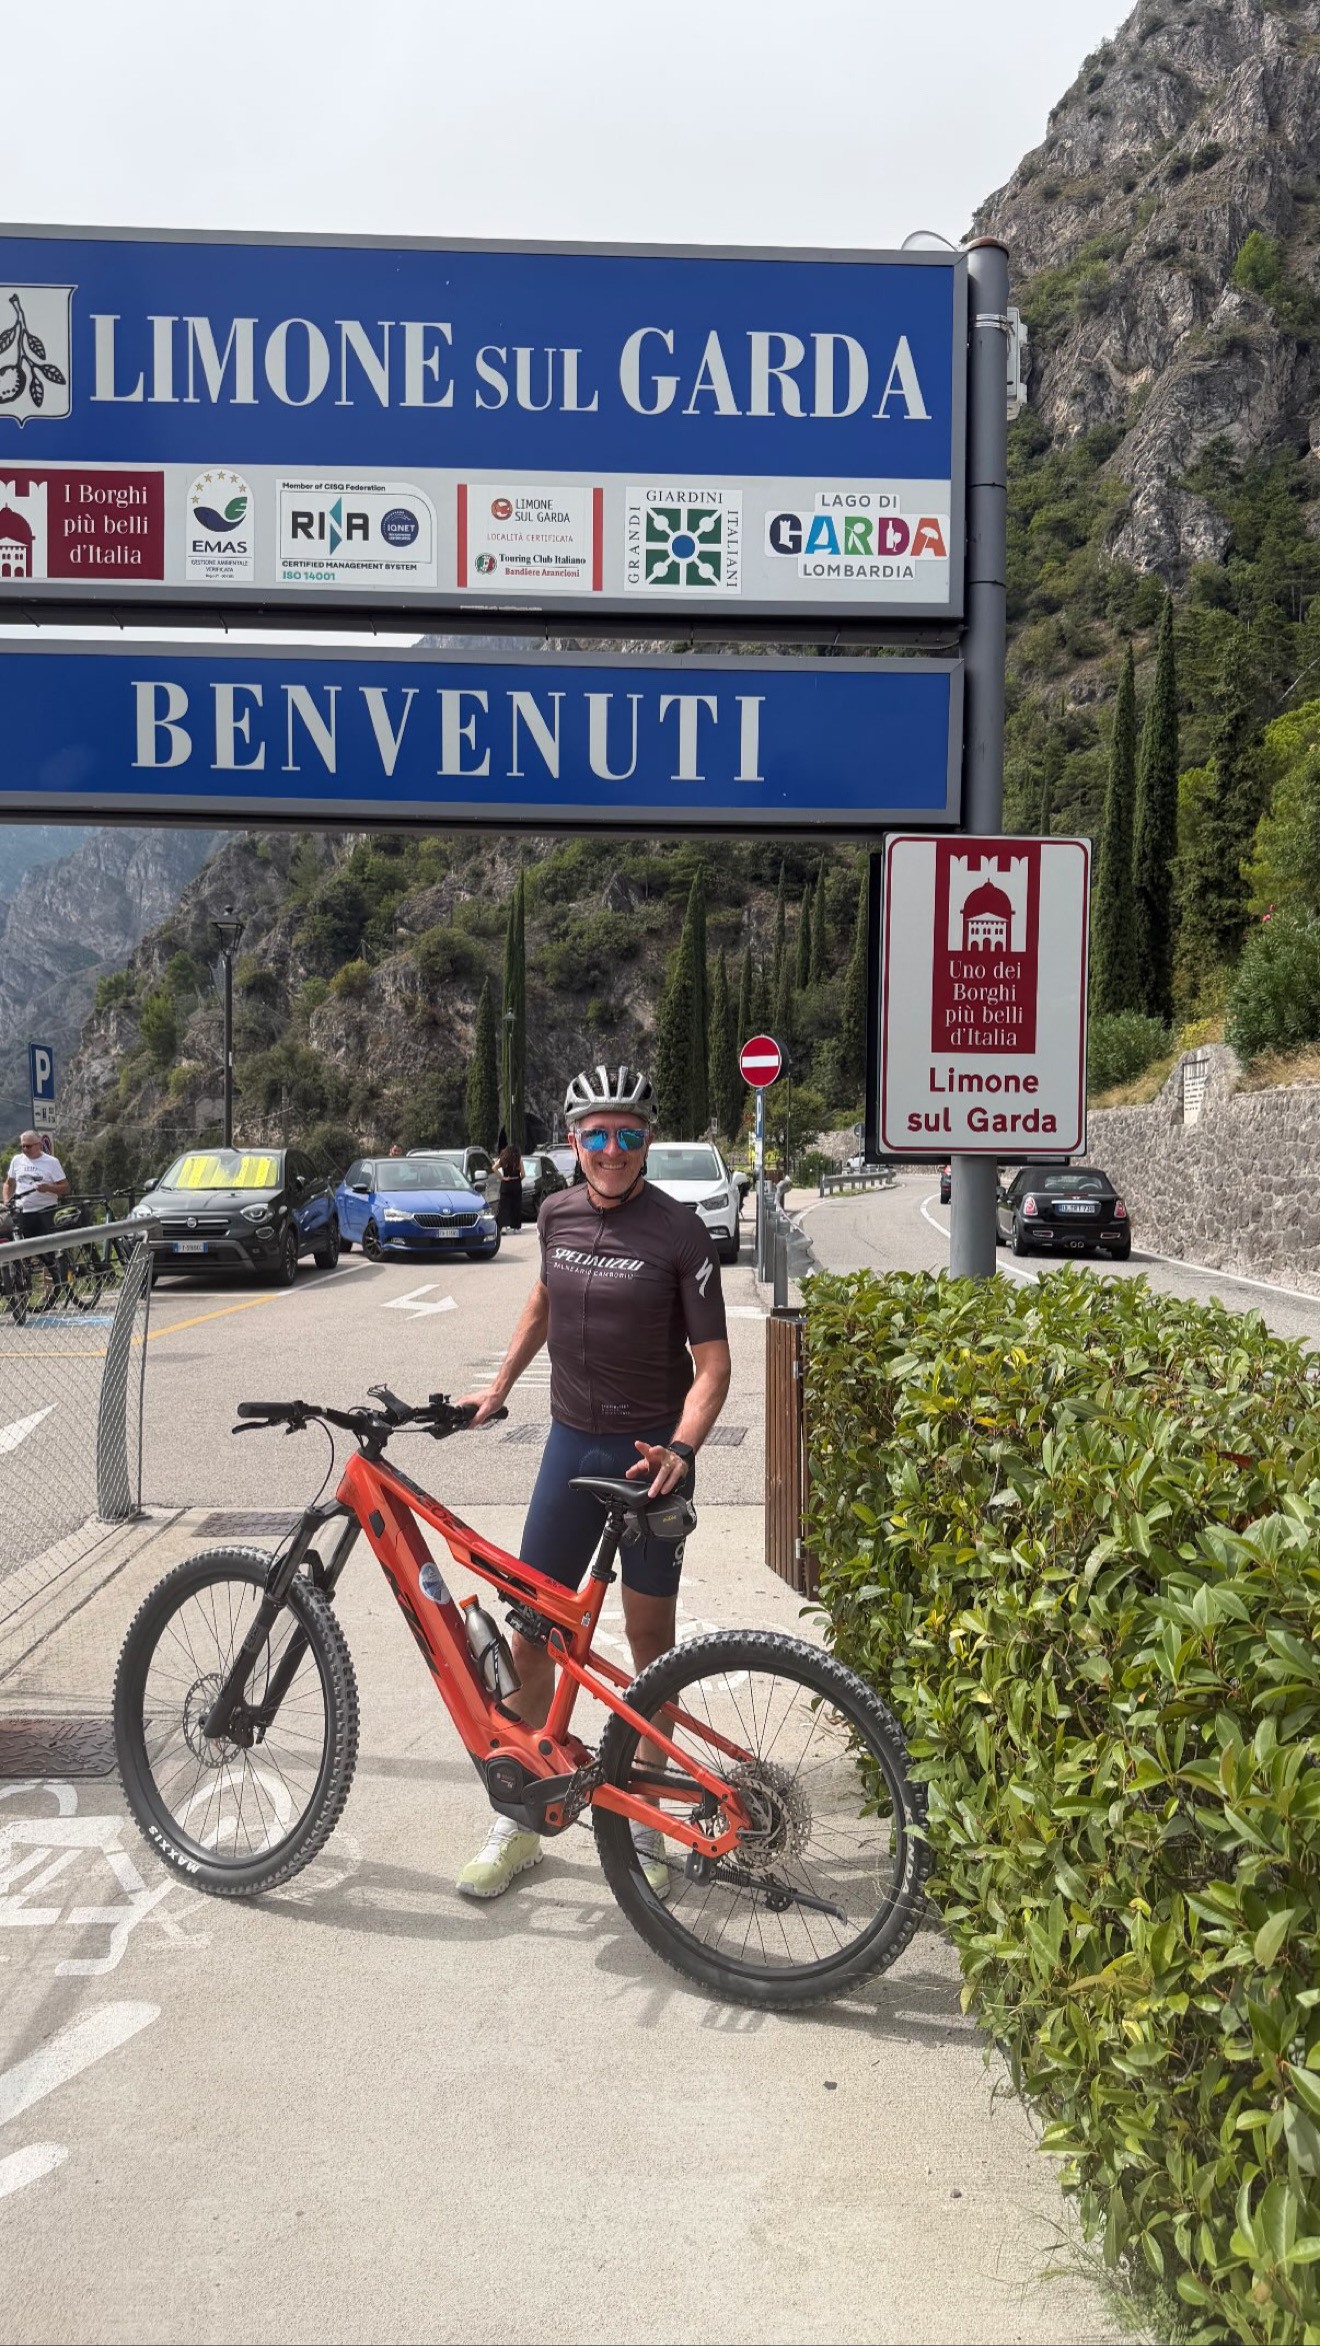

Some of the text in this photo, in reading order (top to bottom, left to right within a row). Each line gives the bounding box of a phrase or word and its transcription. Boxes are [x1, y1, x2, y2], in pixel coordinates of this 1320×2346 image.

[89, 313, 932, 421] LIMONE SUL GARDA
[64, 484, 148, 509] I Borghi
[281, 482, 313, 490] Member
[324, 483, 345, 491] CISQ
[345, 484, 386, 492] Federation
[646, 489, 723, 504] GIARDINI
[515, 498, 554, 510] LIMONE
[821, 494, 897, 508] LAGO DI
[63, 513, 149, 537] più belli
[515, 511, 571, 523] SUL GARDA
[487, 532, 574, 543] LOCALITÀ CERTIFICATA
[628, 506, 641, 584] GRANDI
[769, 513, 947, 557] GARDA
[69, 544, 143, 565] d'Italia
[192, 540, 248, 554] EMAS
[726, 510, 739, 587] ITALIANI
[281, 560, 417, 571] CERTIFIED MANAGEMENT SYSTEM
[498, 553, 587, 565] Touring Club Italiano
[282, 571, 336, 581] ISO 14001
[504, 567, 580, 578] Bandiere Arancioni
[803, 563, 914, 578] LOMBARDIA
[130, 681, 766, 782] BENVENUTI
[949, 960, 1022, 980] Uno dei
[952, 983, 1017, 1005] Borghi
[945, 1005, 1024, 1027] più belli
[950, 1028, 1018, 1046] d'Italia
[35, 1049, 51, 1094] P
[929, 1067, 1039, 1094] Limone
[907, 1106, 1058, 1133] sul Garda
[552, 1248, 645, 1271] SPECIALIZED
[148, 1825, 200, 1874] MAXXIS
